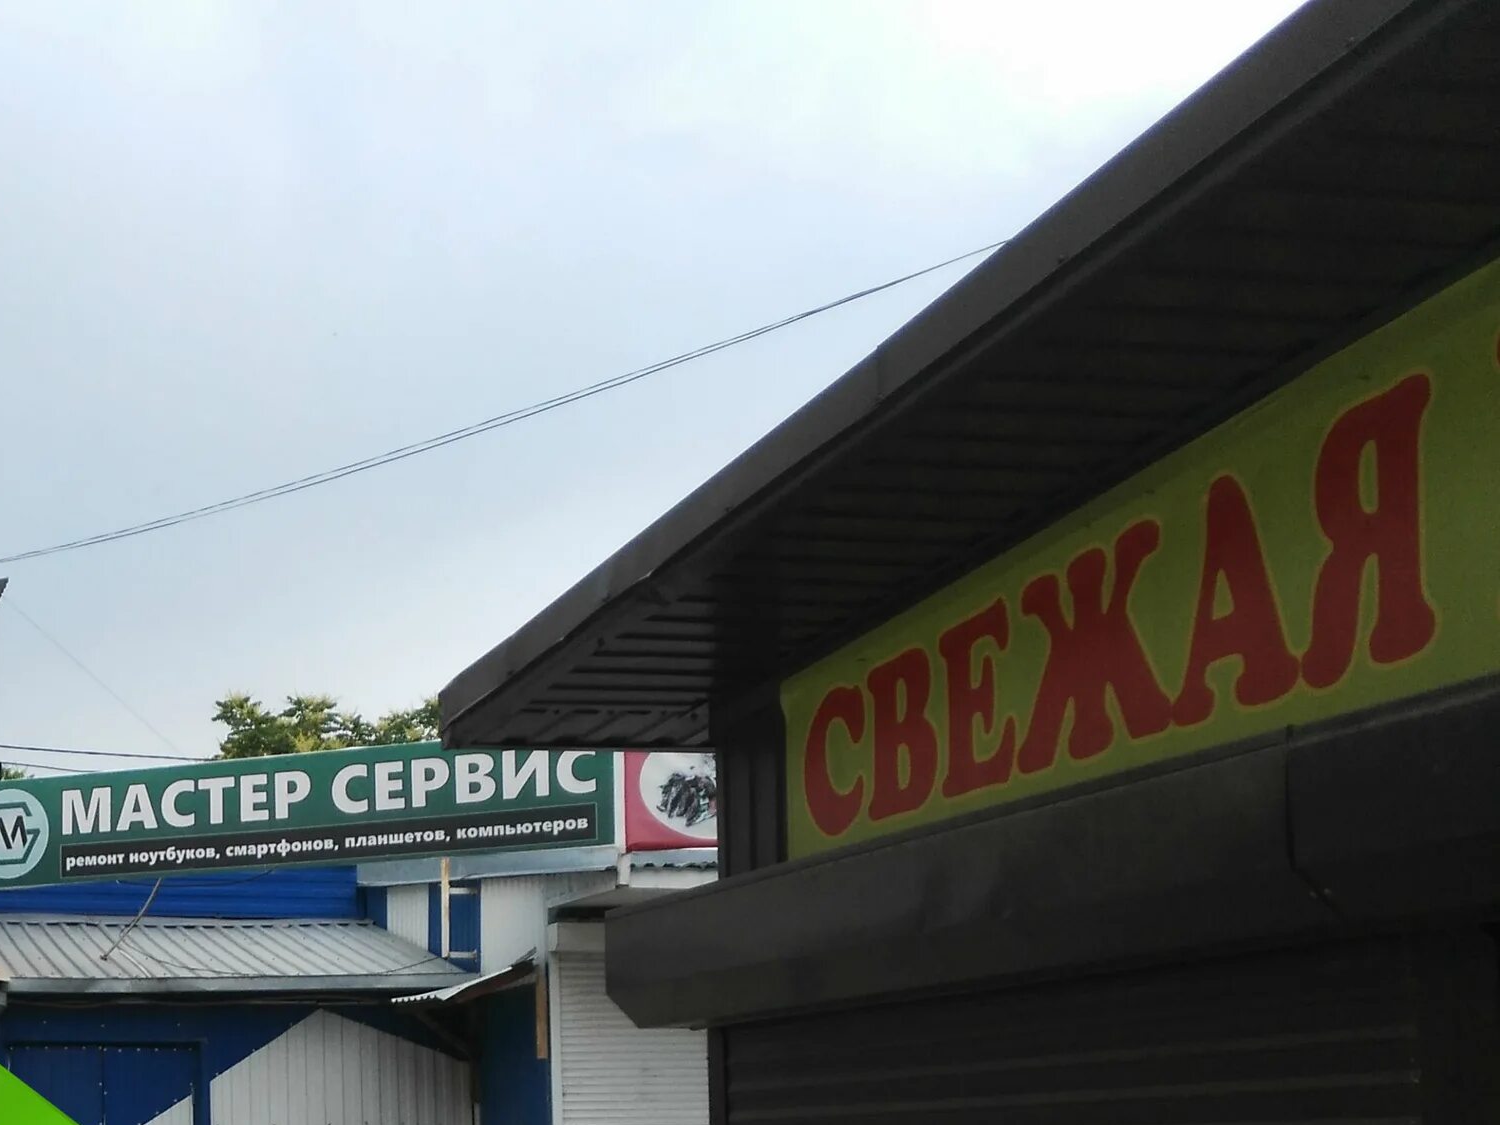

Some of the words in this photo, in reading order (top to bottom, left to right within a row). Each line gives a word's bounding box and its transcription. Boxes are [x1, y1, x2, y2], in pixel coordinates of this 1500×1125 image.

[803, 372, 1437, 838] СВЕЖАЯ
[60, 770, 312, 836] МАСТЕР
[331, 749, 597, 814] СЕРВИС
[65, 852, 124, 871] ремонт
[129, 845, 220, 866] ноутбуков,
[225, 837, 340, 860] смартфонов,
[345, 828, 451, 849] планшетов,
[456, 816, 589, 839] компьютеров
